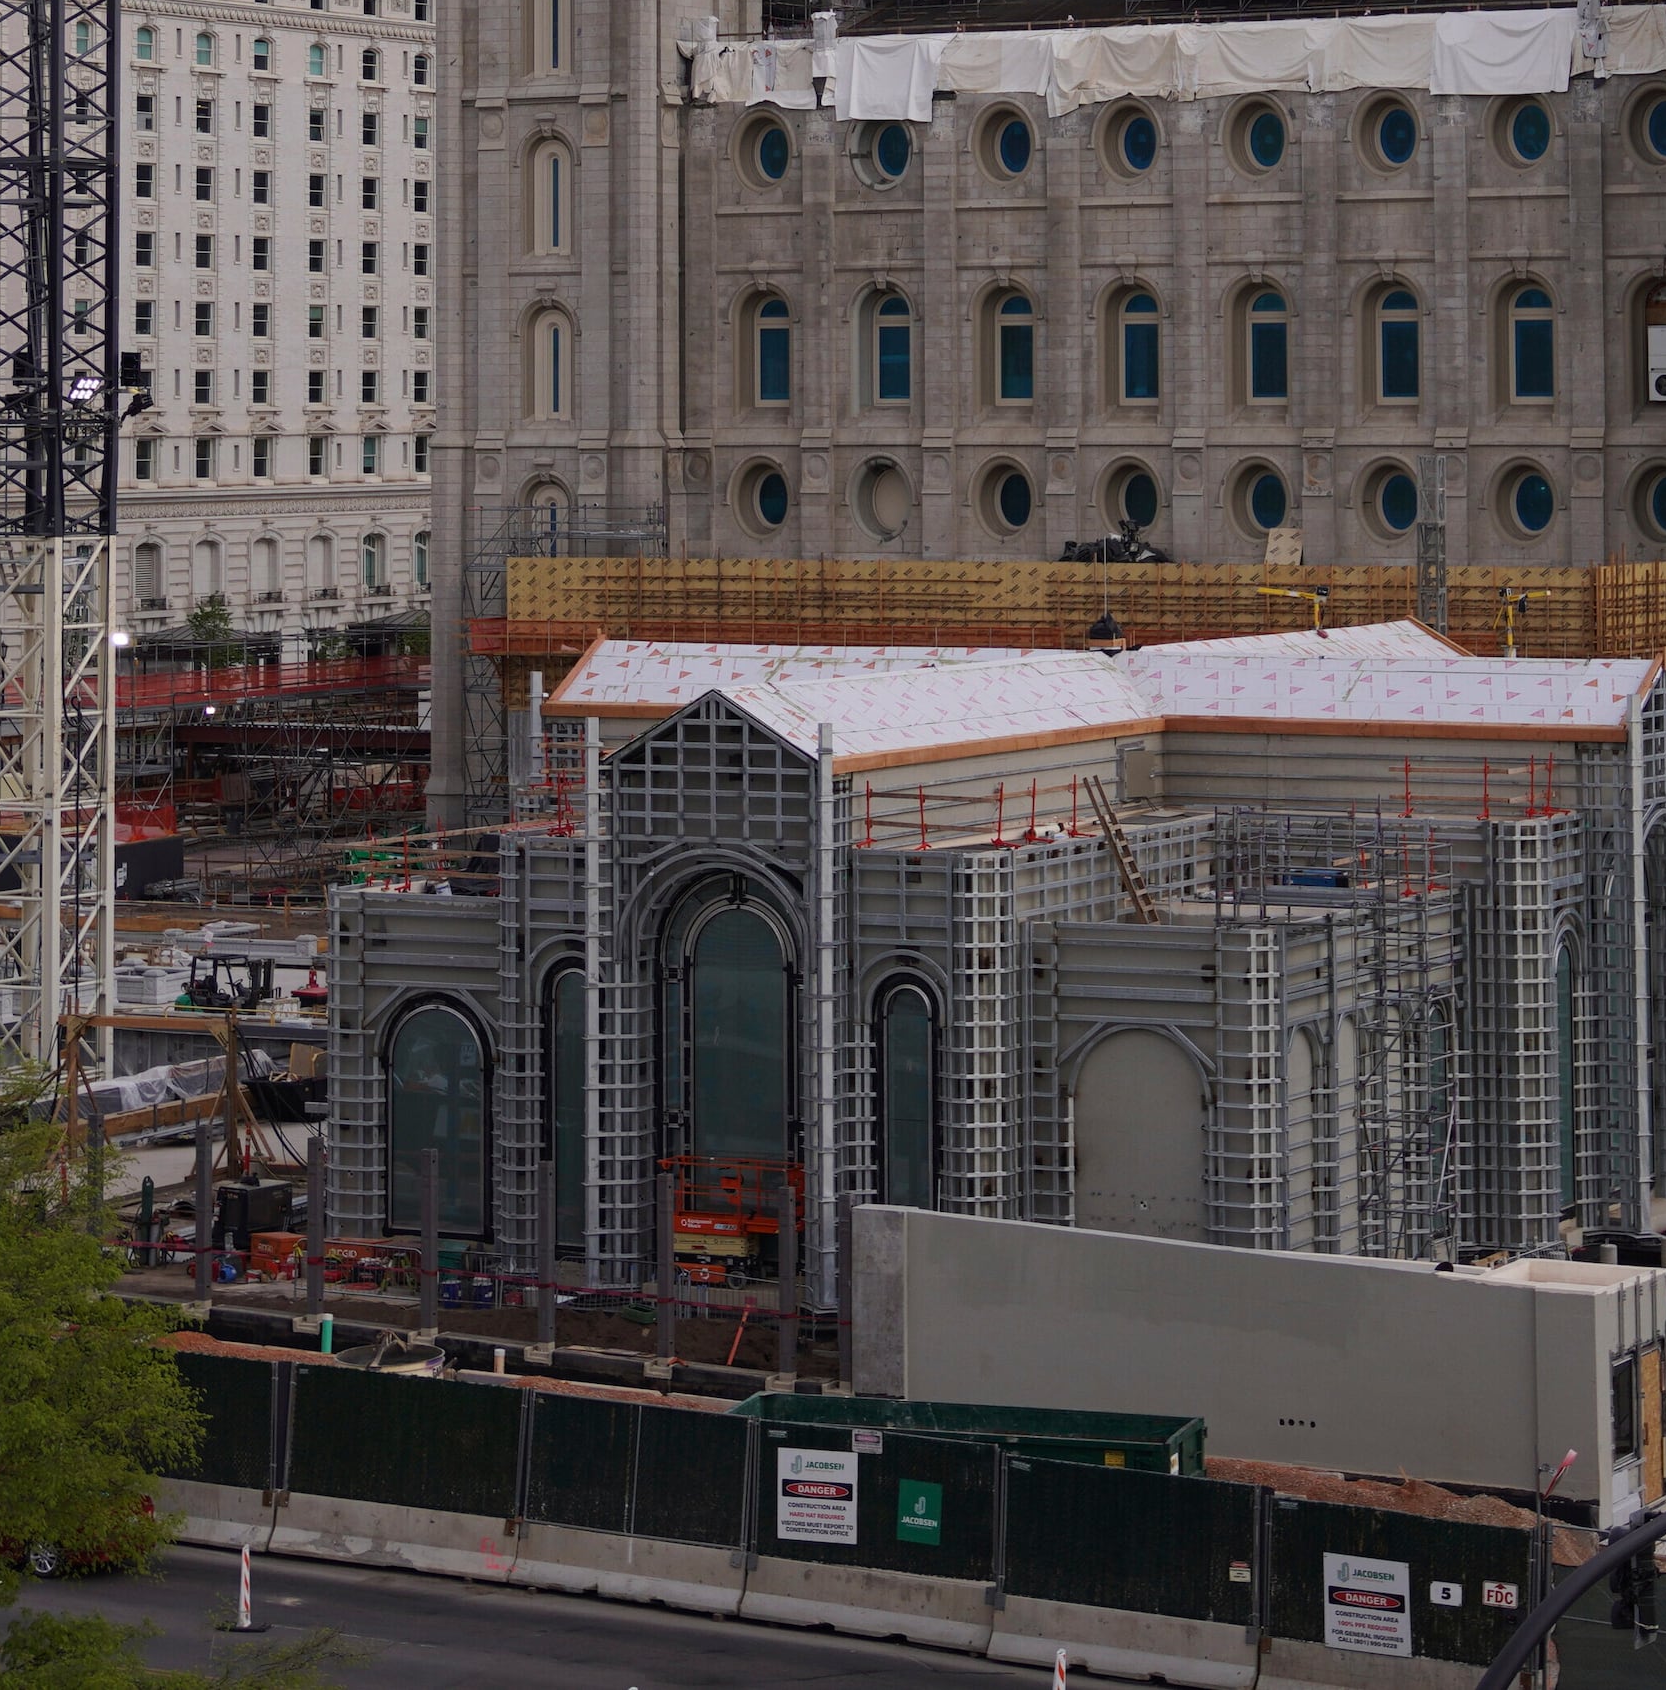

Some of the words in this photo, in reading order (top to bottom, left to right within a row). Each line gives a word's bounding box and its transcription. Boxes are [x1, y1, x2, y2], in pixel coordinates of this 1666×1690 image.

[805, 1461, 845, 1471] JACOBSEN
[797, 1484, 837, 1496] DANGER
[787, 1502, 831, 1511] CONSTRUCTION
[817, 1513, 845, 1521] REQUIRED
[901, 1516, 938, 1527] JACOBSEN
[785, 1526, 829, 1535] CONSTRUCTION
[1352, 1568, 1395, 1582] JACOBSEN
[1441, 1587, 1451, 1600] 5
[1486, 1589, 1514, 1605] FDC
[1345, 1593, 1387, 1606] DANGER
[1335, 1610, 1382, 1621] CONSTRUCTION
[1367, 1623, 1398, 1633] REQUIRED
[1332, 1628, 1344, 1636] FOR
[1344, 1630, 1373, 1639] GENERAL
[1373, 1634, 1404, 1643] INQUIRIES
[1338, 1636, 1354, 1644] CALL
